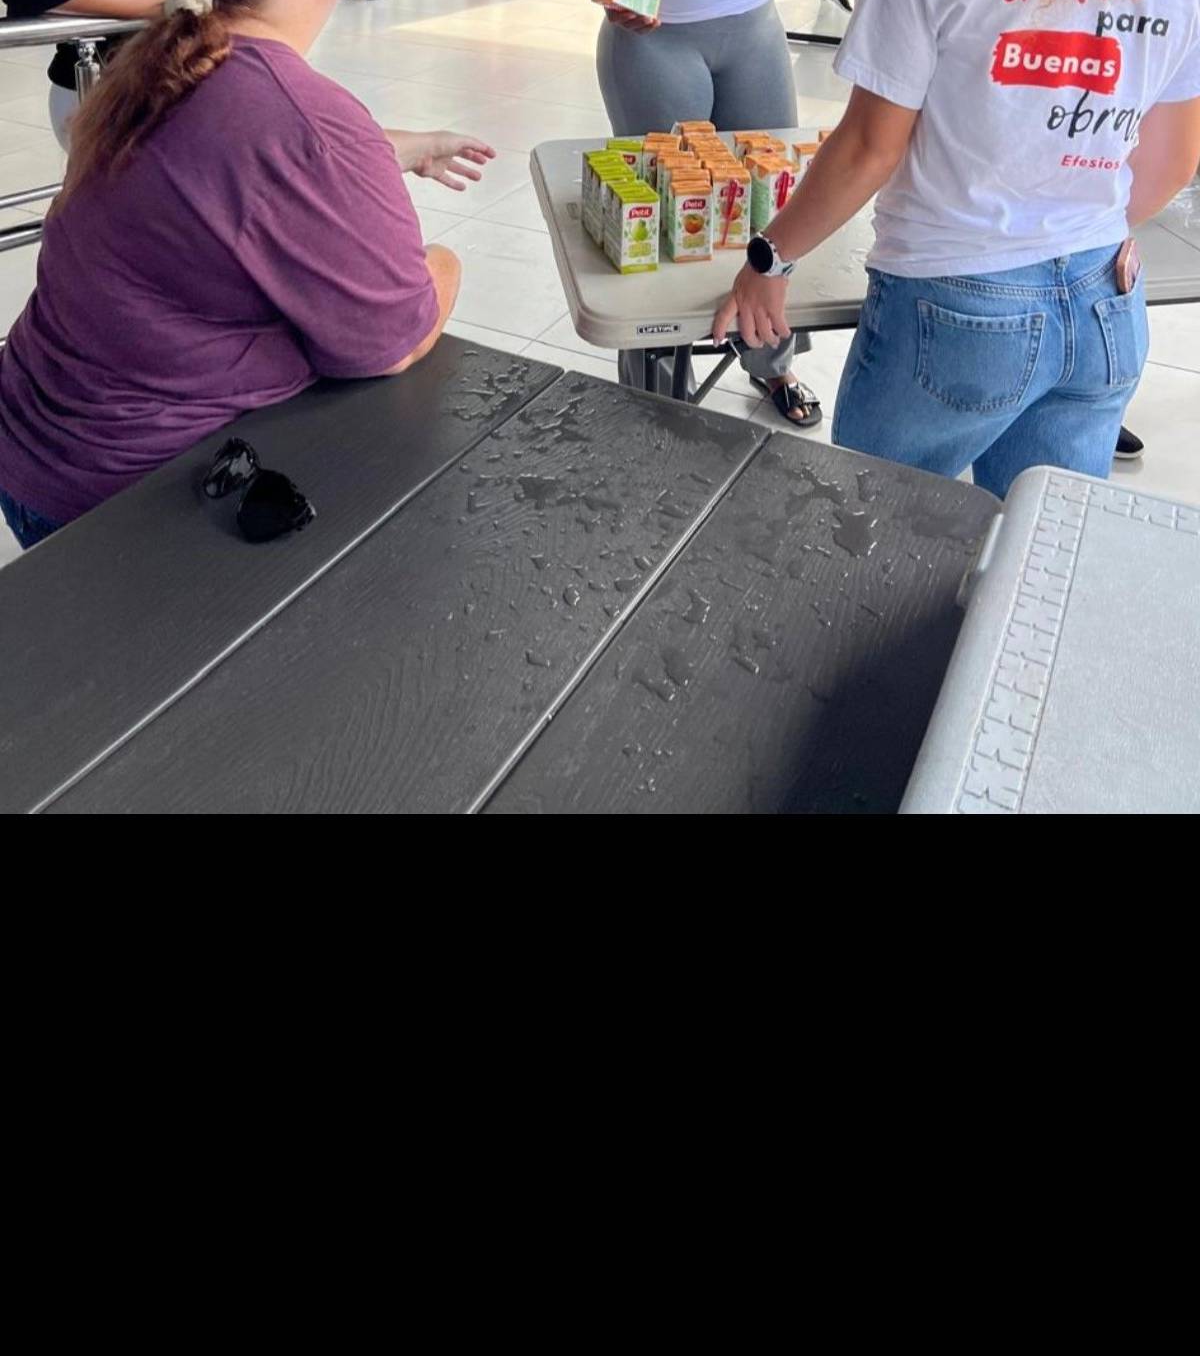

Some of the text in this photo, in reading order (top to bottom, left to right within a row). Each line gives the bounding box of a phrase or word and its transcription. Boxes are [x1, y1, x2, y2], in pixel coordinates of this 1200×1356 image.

[1096, 11, 1169, 37] para
[1002, 43, 1116, 77] Buenas
[630, 208, 651, 218] Petit
